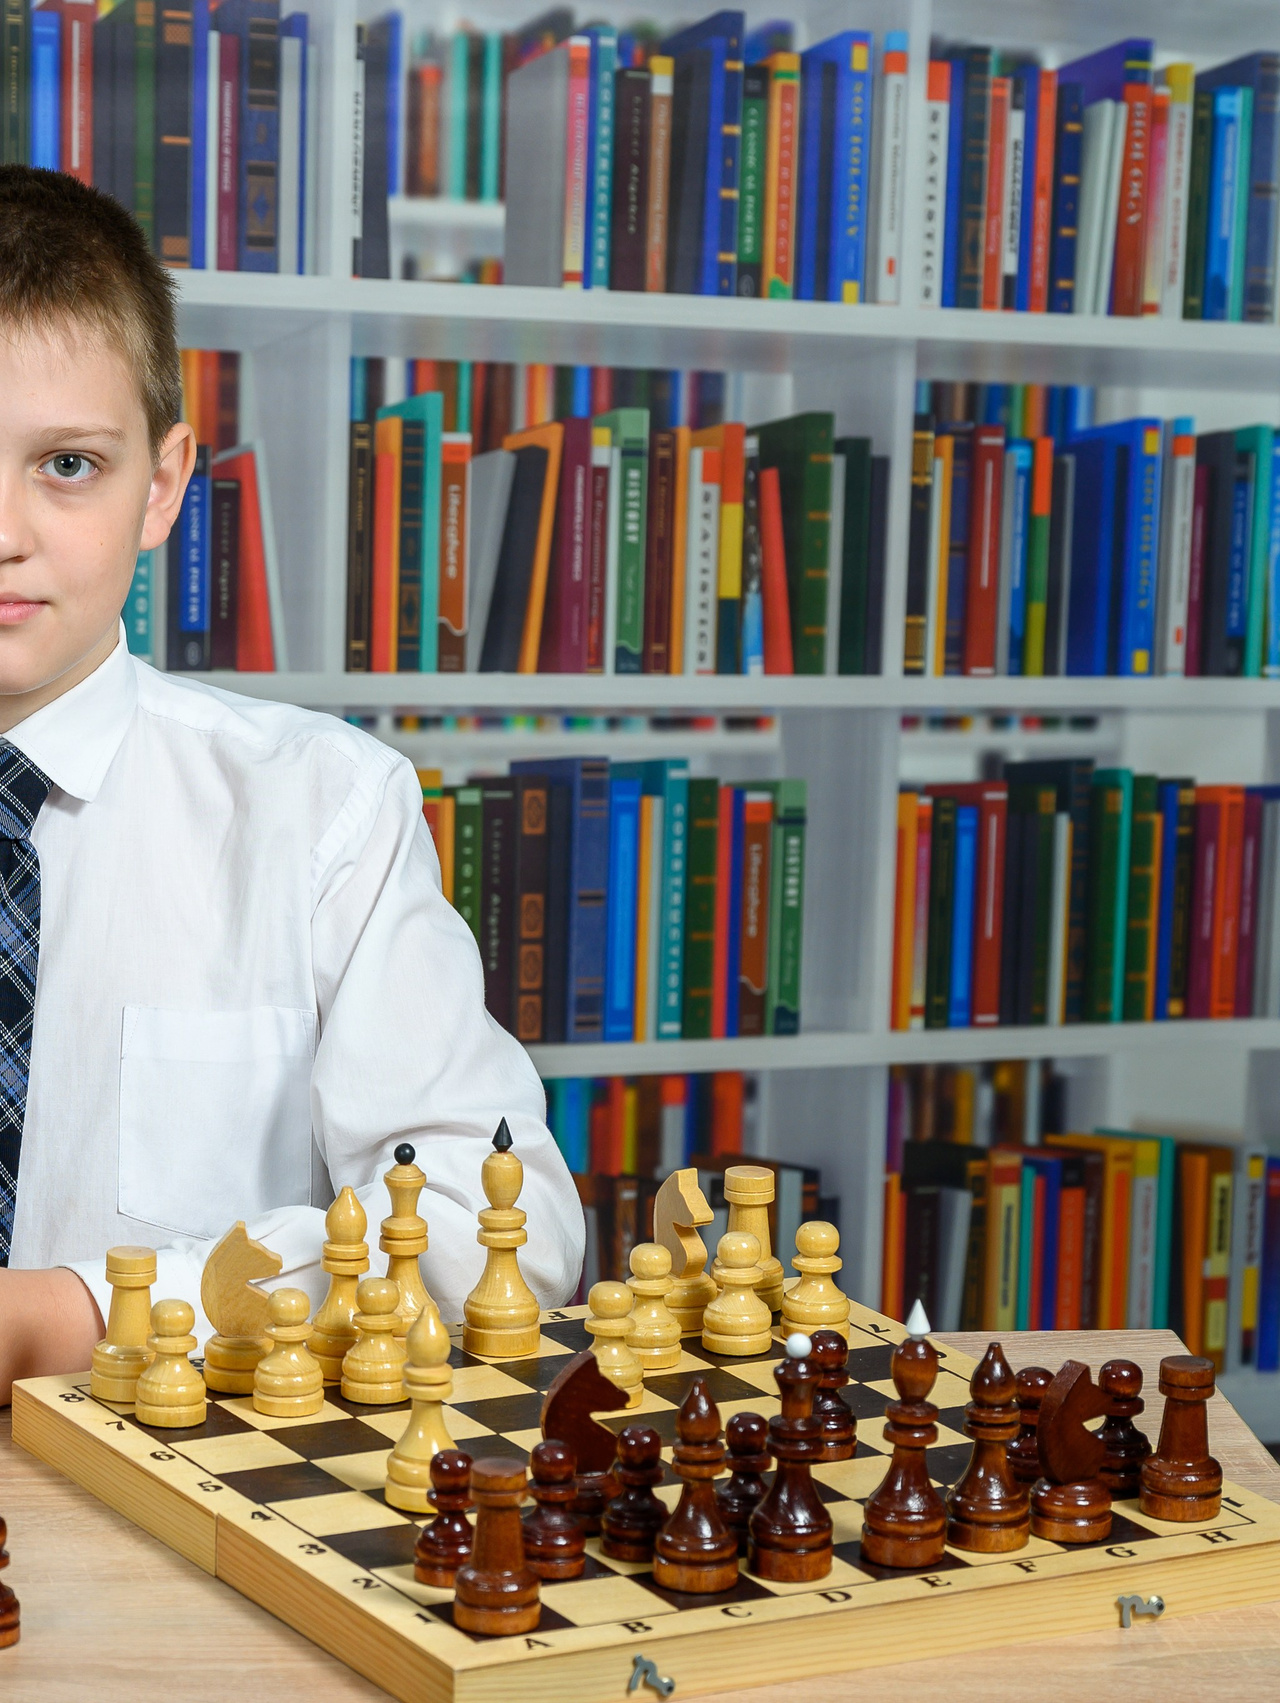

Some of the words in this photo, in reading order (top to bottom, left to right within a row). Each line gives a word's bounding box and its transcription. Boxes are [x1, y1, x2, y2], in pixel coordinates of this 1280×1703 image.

[595, 70, 613, 271] CONSTRUCTION
[922, 109, 940, 302] STATISTICS
[446, 484, 462, 580] Literature
[624, 469, 642, 544] HISTORY
[697, 489, 713, 665] STATISTICS
[666, 802, 685, 1008] CONSTRUCTION
[746, 843, 763, 939] Literature
[784, 836, 801, 908] HISTORY
[487, 893, 502, 971] Algebra
[58, 1392, 86, 1404] 8
[105, 1421, 125, 1432] 7
[149, 1450, 177, 1462] 6
[197, 1480, 224, 1493] 5
[250, 1510, 277, 1522] 4
[298, 1543, 327, 1556] 3
[352, 1577, 383, 1591] 2
[413, 1612, 438, 1625] 1
[524, 1636, 555, 1651] A
[618, 1621, 654, 1635] B
[720, 1605, 752, 1619] C
[815, 1590, 853, 1604] D
[917, 1574, 953, 1589] E
[1011, 1560, 1039, 1574] F
[1104, 1546, 1138, 1559] G
[1196, 1530, 1238, 1545] H
